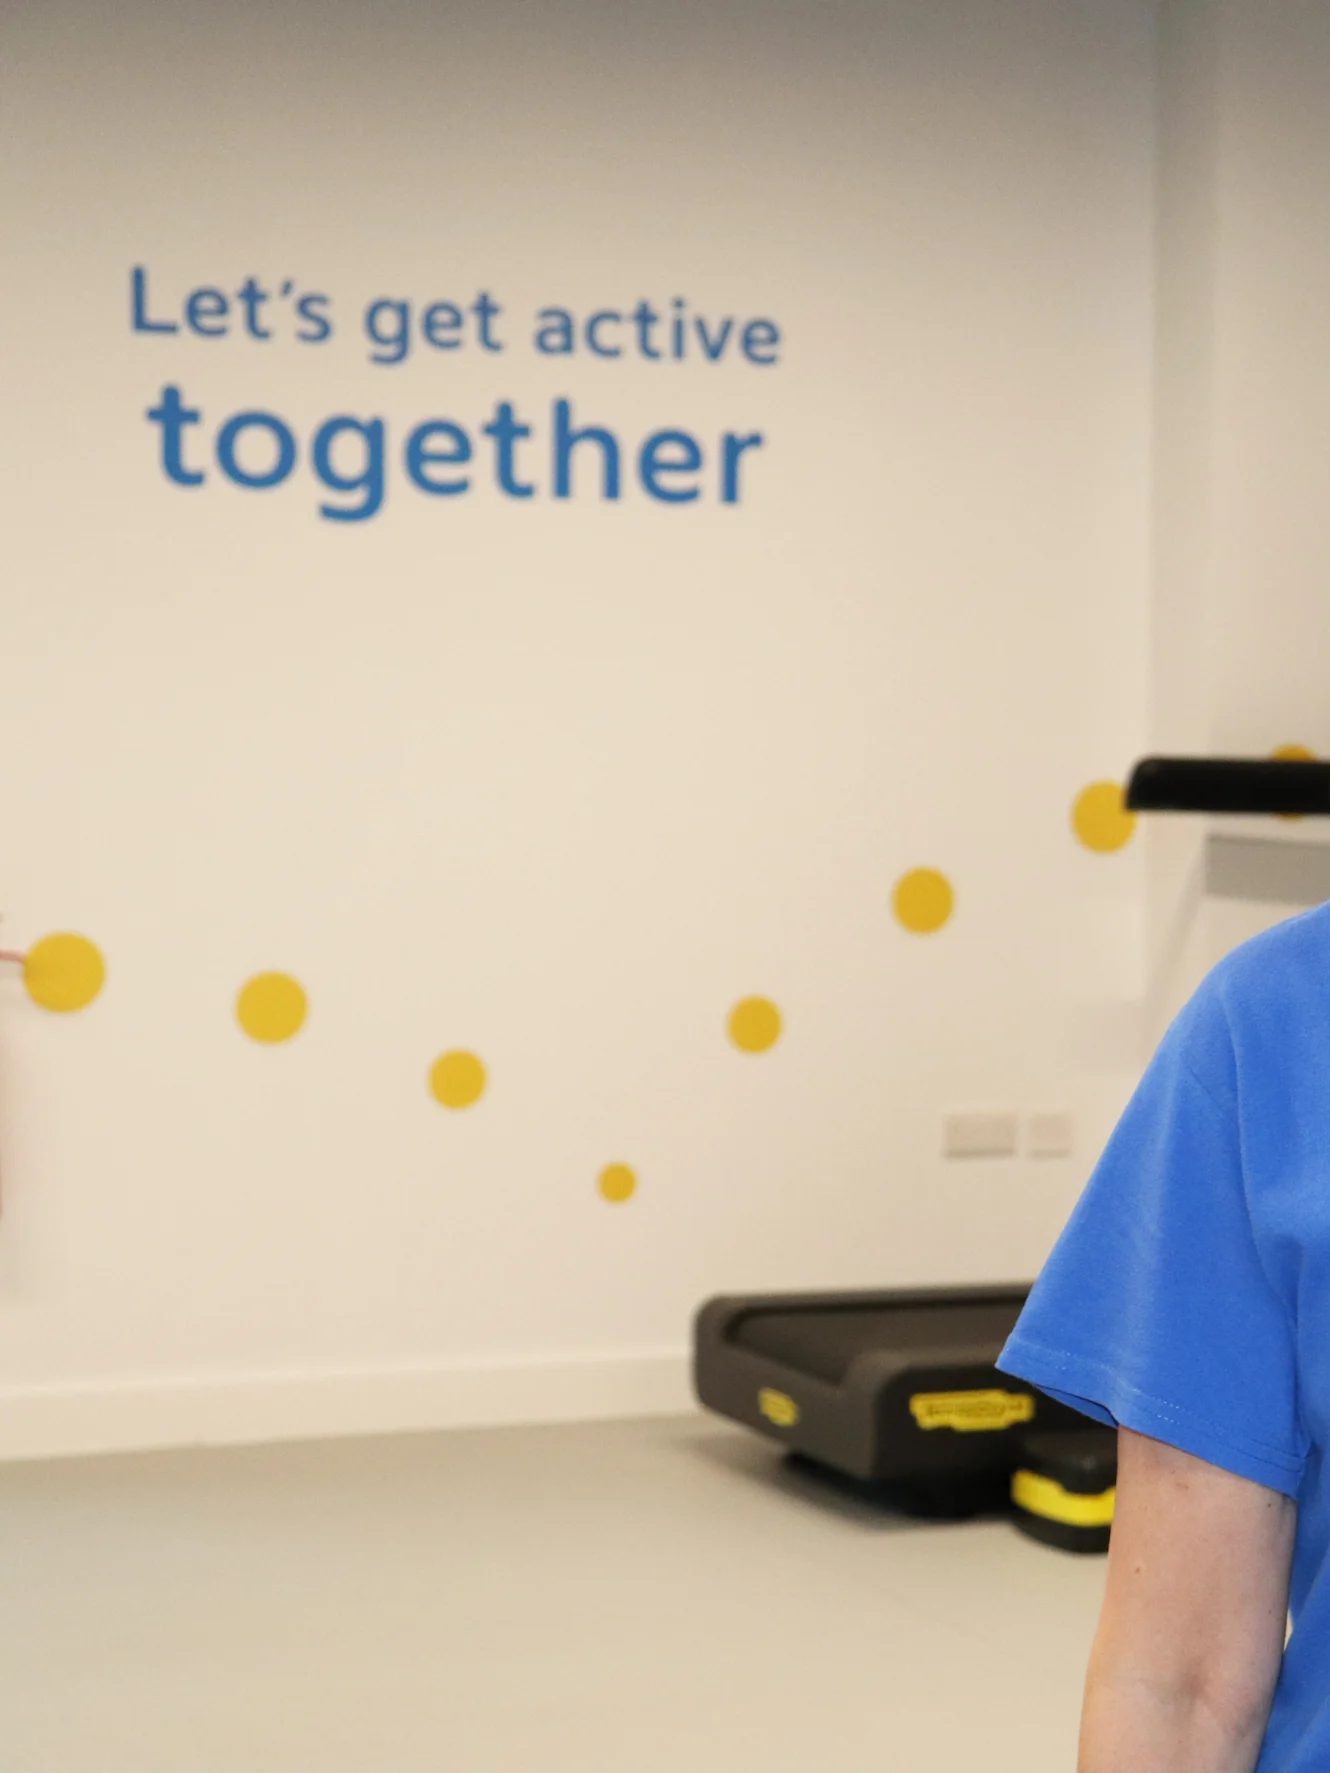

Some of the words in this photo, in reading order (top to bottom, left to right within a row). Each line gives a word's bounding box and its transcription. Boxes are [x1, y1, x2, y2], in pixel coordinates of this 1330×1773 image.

[130, 266, 333, 344] Let's
[363, 293, 504, 366] get
[533, 299, 782, 366] active
[145, 384, 764, 523] together
